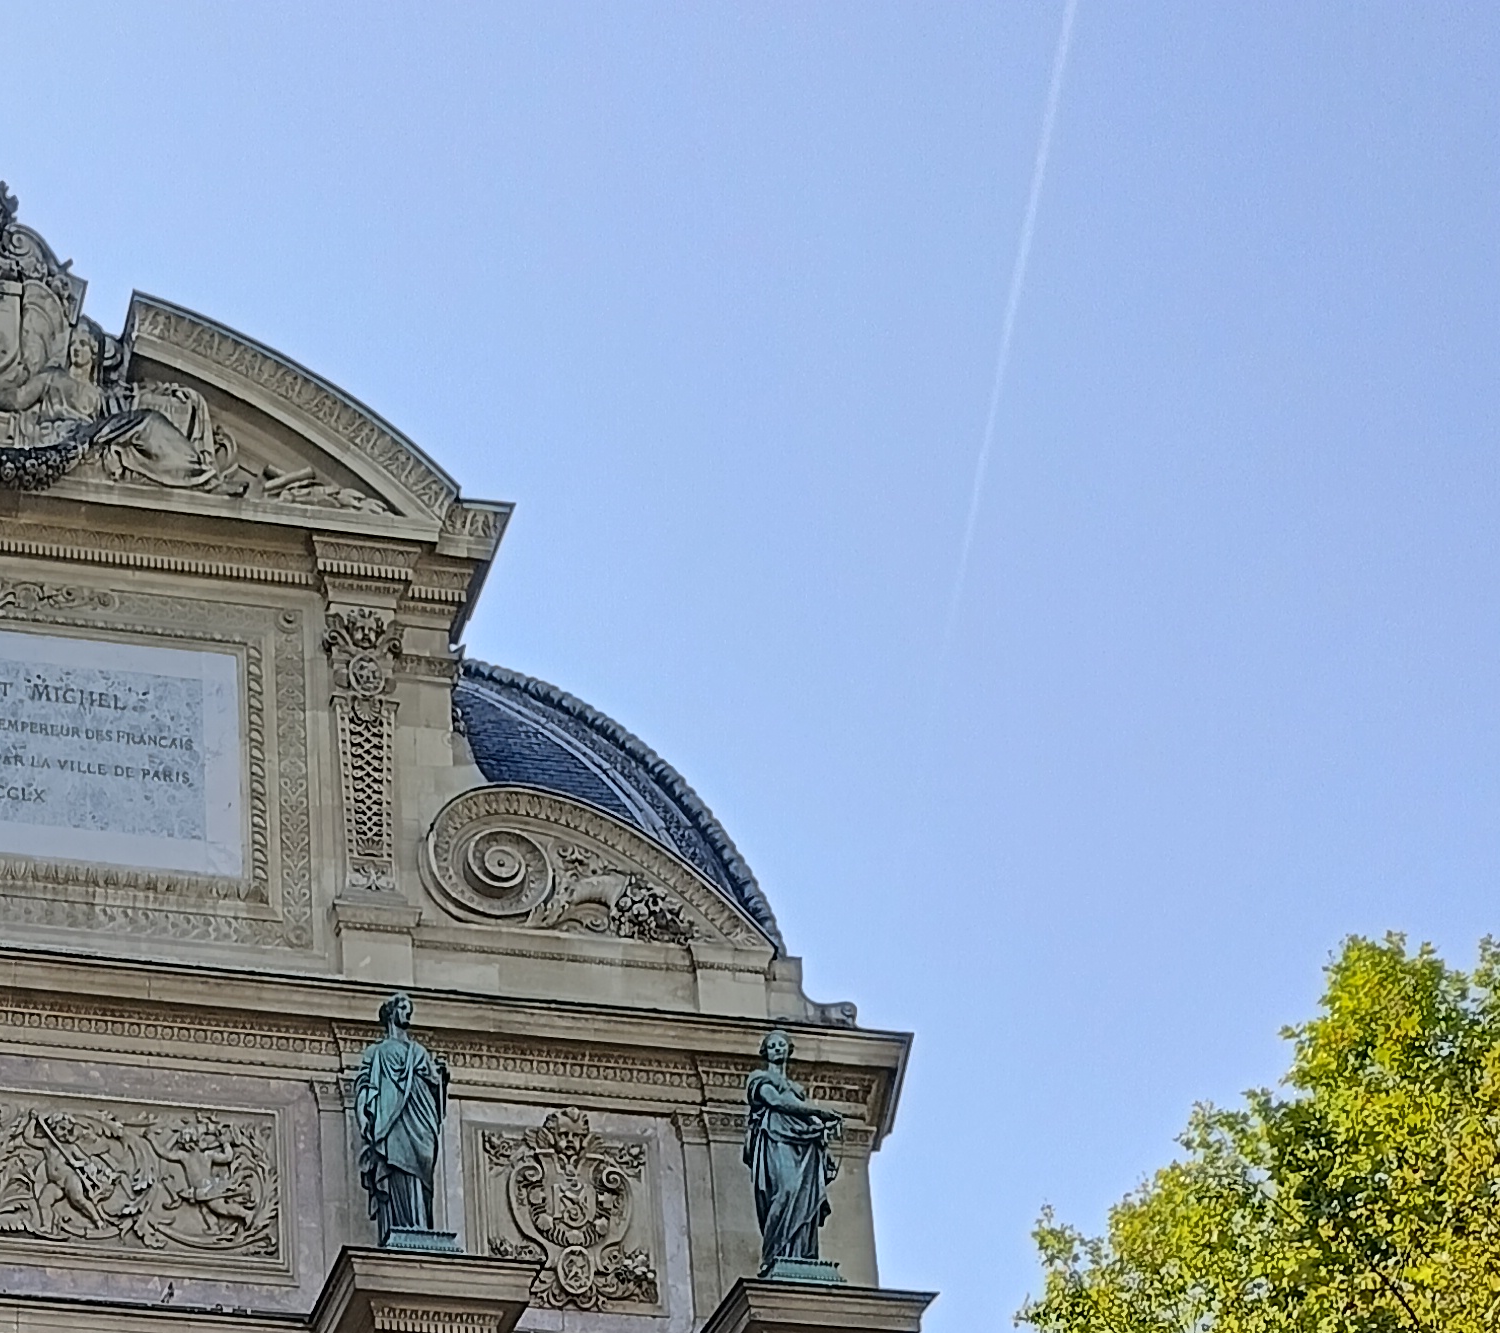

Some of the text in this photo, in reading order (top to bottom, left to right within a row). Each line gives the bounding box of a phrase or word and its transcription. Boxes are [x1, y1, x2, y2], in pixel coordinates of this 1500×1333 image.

[30, 684, 127, 711] MICHEL
[84, 728, 113, 743] DES
[30, 755, 51, 769] LA
[57, 759, 107, 776] VILLE
[114, 764, 135, 779] DE
